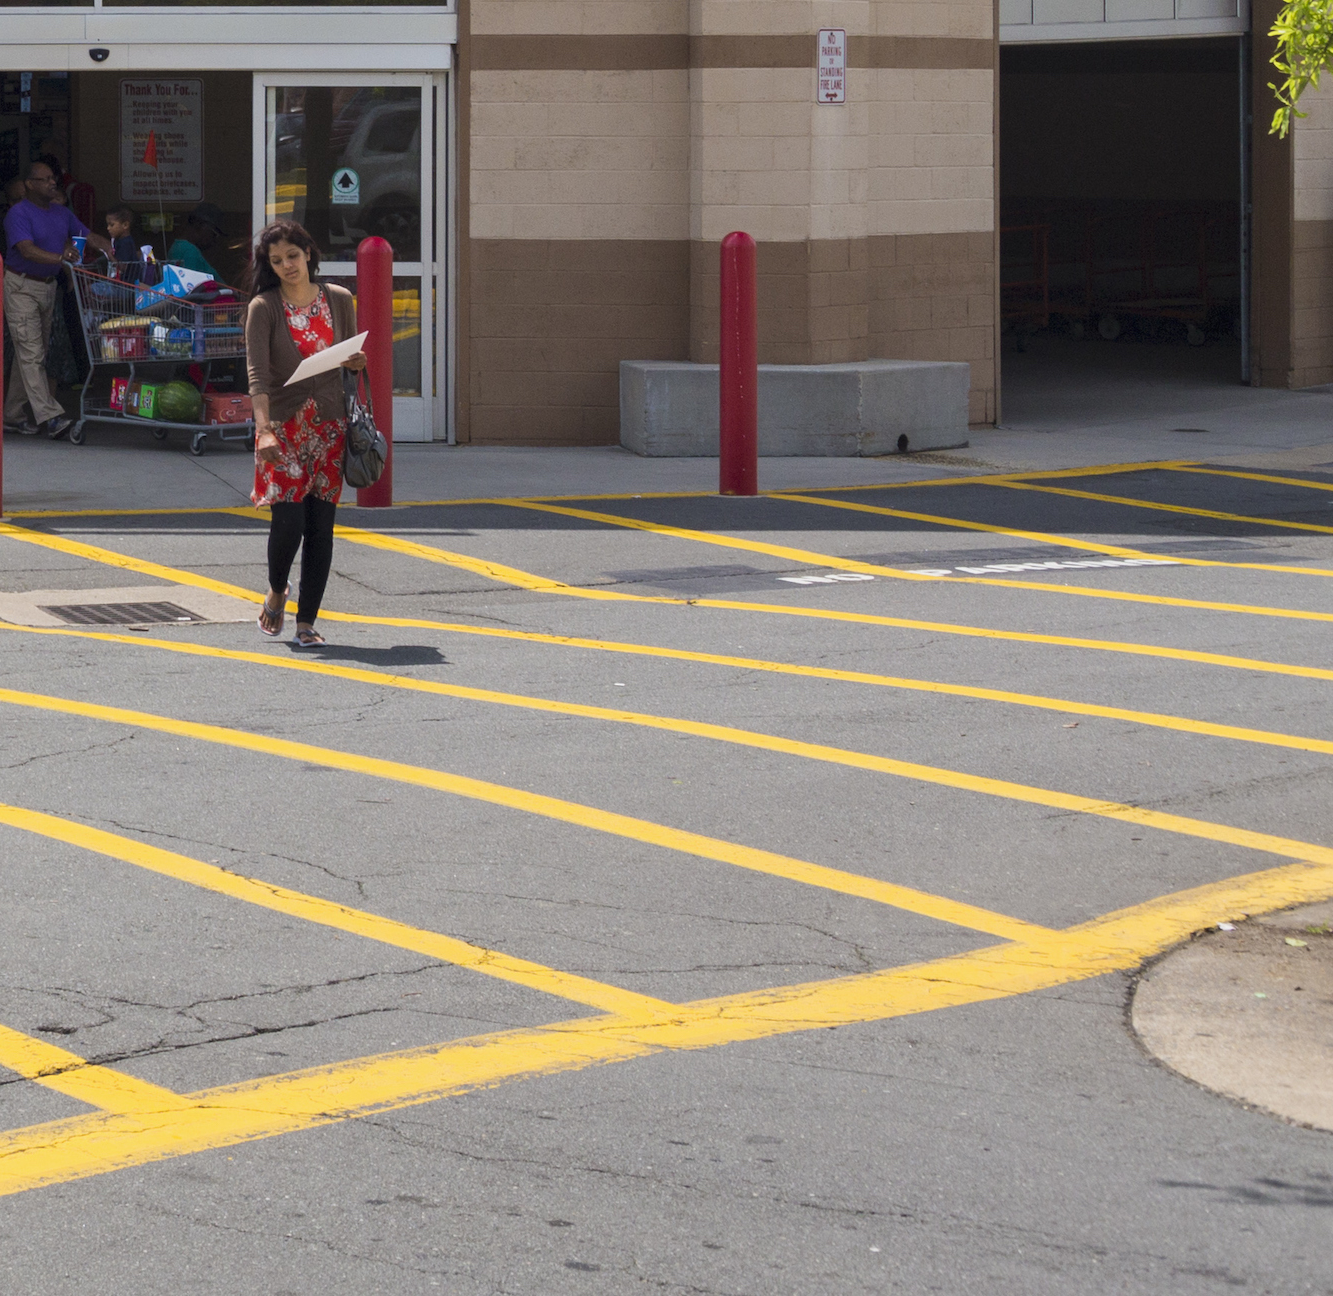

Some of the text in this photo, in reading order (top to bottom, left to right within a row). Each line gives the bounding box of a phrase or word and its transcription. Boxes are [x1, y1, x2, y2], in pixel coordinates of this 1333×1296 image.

[125, 84, 152, 96] Thank
[155, 84, 171, 96] You
[775, 558, 1183, 585] NO PARKING
